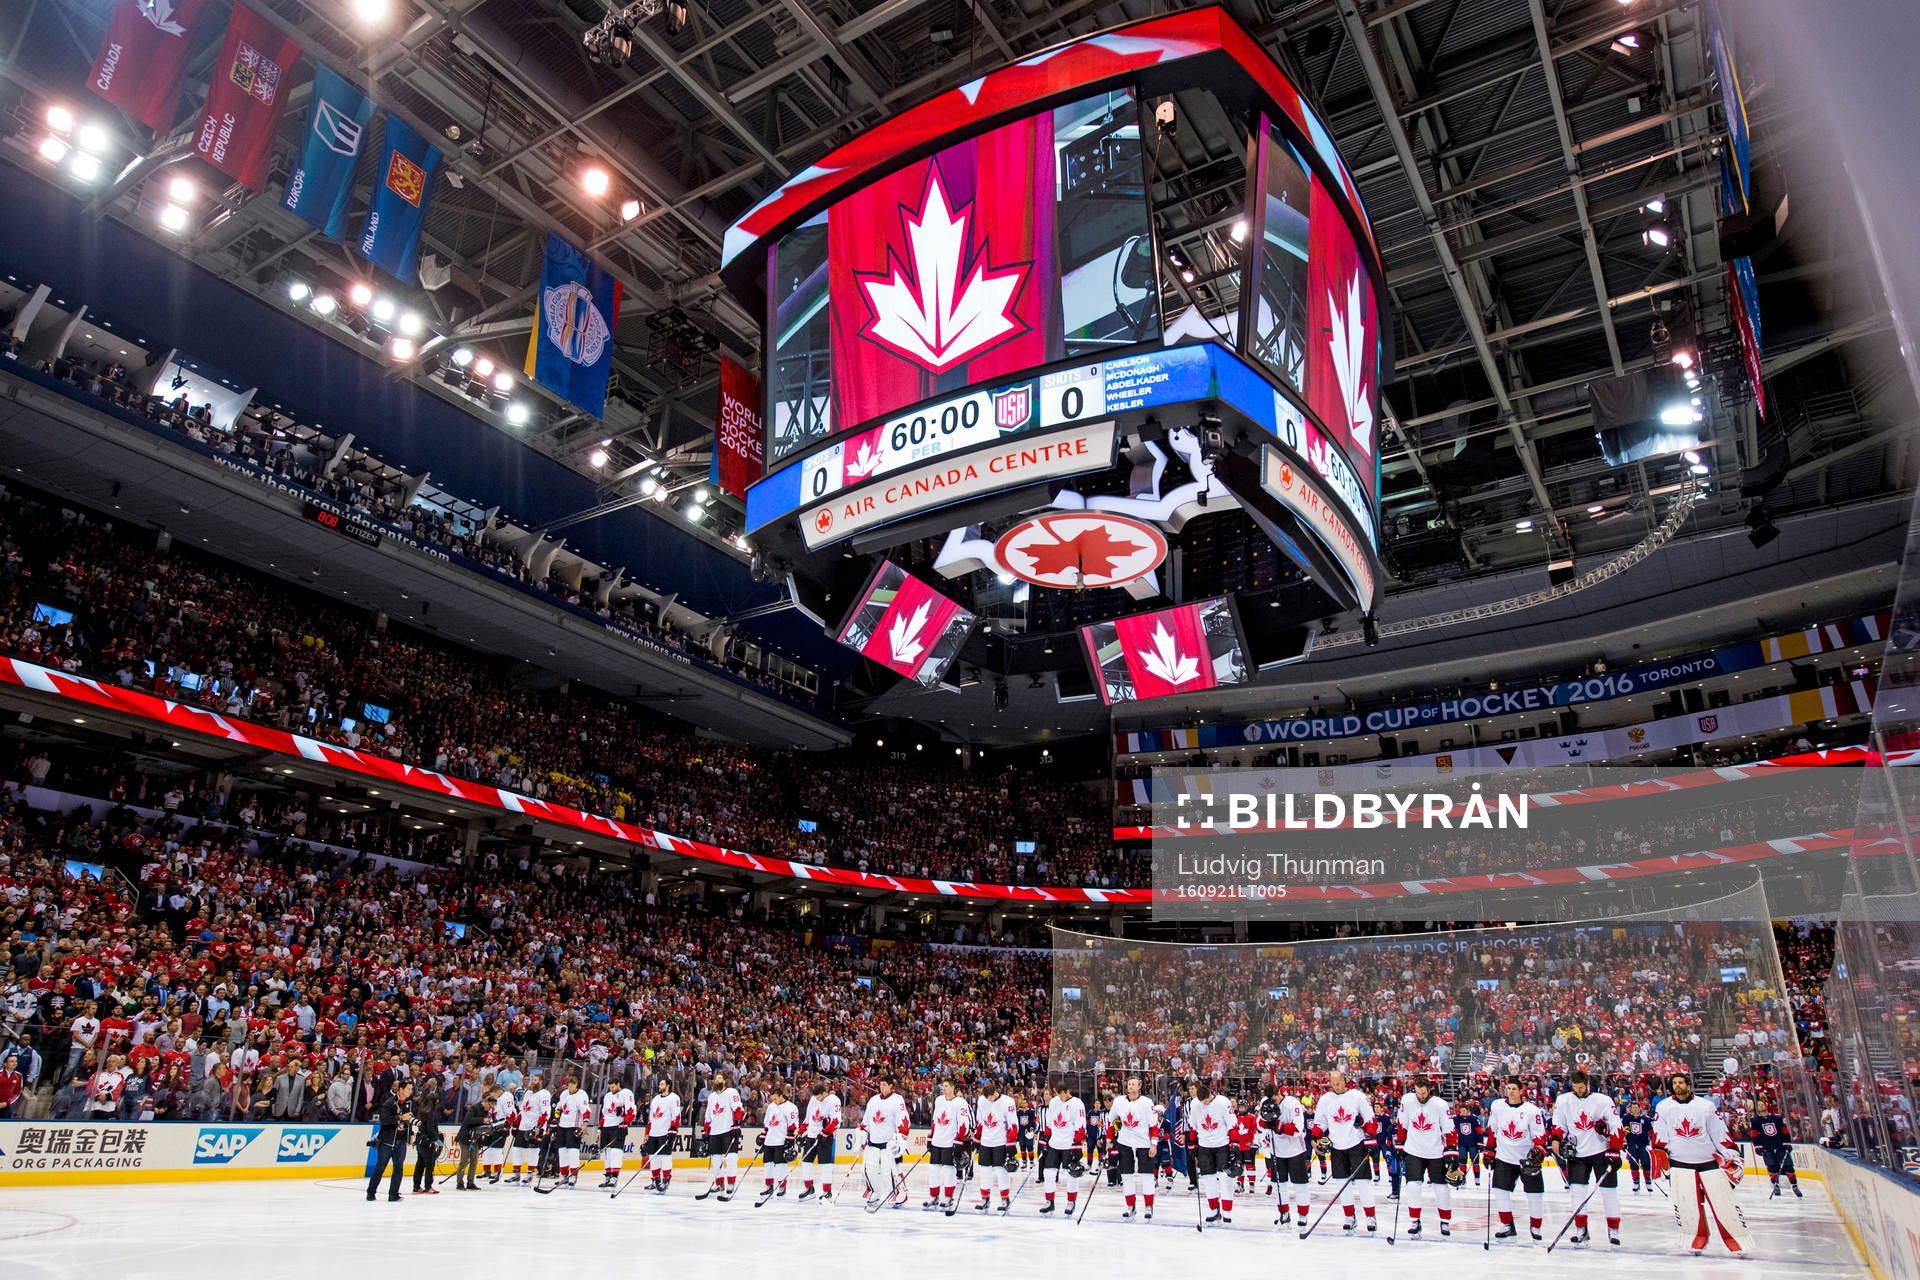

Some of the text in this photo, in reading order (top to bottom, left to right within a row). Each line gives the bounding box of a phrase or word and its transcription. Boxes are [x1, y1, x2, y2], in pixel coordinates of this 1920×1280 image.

[97, 43, 122, 91] CANADA
[198, 115, 217, 153] CZECH
[212, 113, 235, 163] REPUBLIC
[286, 168, 305, 209] EUROPE
[361, 212, 380, 255] FINLAND
[1044, 366, 1098, 388] SHOTS 0
[1105, 356, 1150, 371] CARLSON
[1105, 365, 1160, 381] MCDONAGH
[1106, 373, 1169, 391] ABDELKADER
[1106, 387, 1152, 401] WHEELER
[998, 391, 1028, 426] USA
[1061, 387, 1084, 419] 0
[1106, 399, 1144, 412] KESLER
[722, 406, 757, 435] CUP OF
[891, 400, 980, 452] 60:00
[1286, 418, 1299, 449] 0
[720, 431, 748, 458] 2016
[721, 418, 762, 455] HOCKE
[912, 441, 941, 460] PER
[813, 467, 827, 497] 0
[843, 438, 1089, 520] AIR CANADA CENTRE
[345, 523, 378, 542] CITIZEN
[1298, 484, 1319, 512] AIR
[1321, 505, 1356, 557] CANADA
[1265, 658, 1716, 741] WORLD CUP OF HOCKEY 2016 TORONTO
[1701, 717, 1716, 732] USA
[15, 1128, 148, 1154] 奥瑞金包装
[196, 1133, 247, 1158] SAP
[278, 1133, 325, 1157] SAP
[914, 1136, 927, 1147] AIR
[12, 1156, 143, 1169] ORG PACKAGING
[1735, 1205, 1748, 1229] CCM
